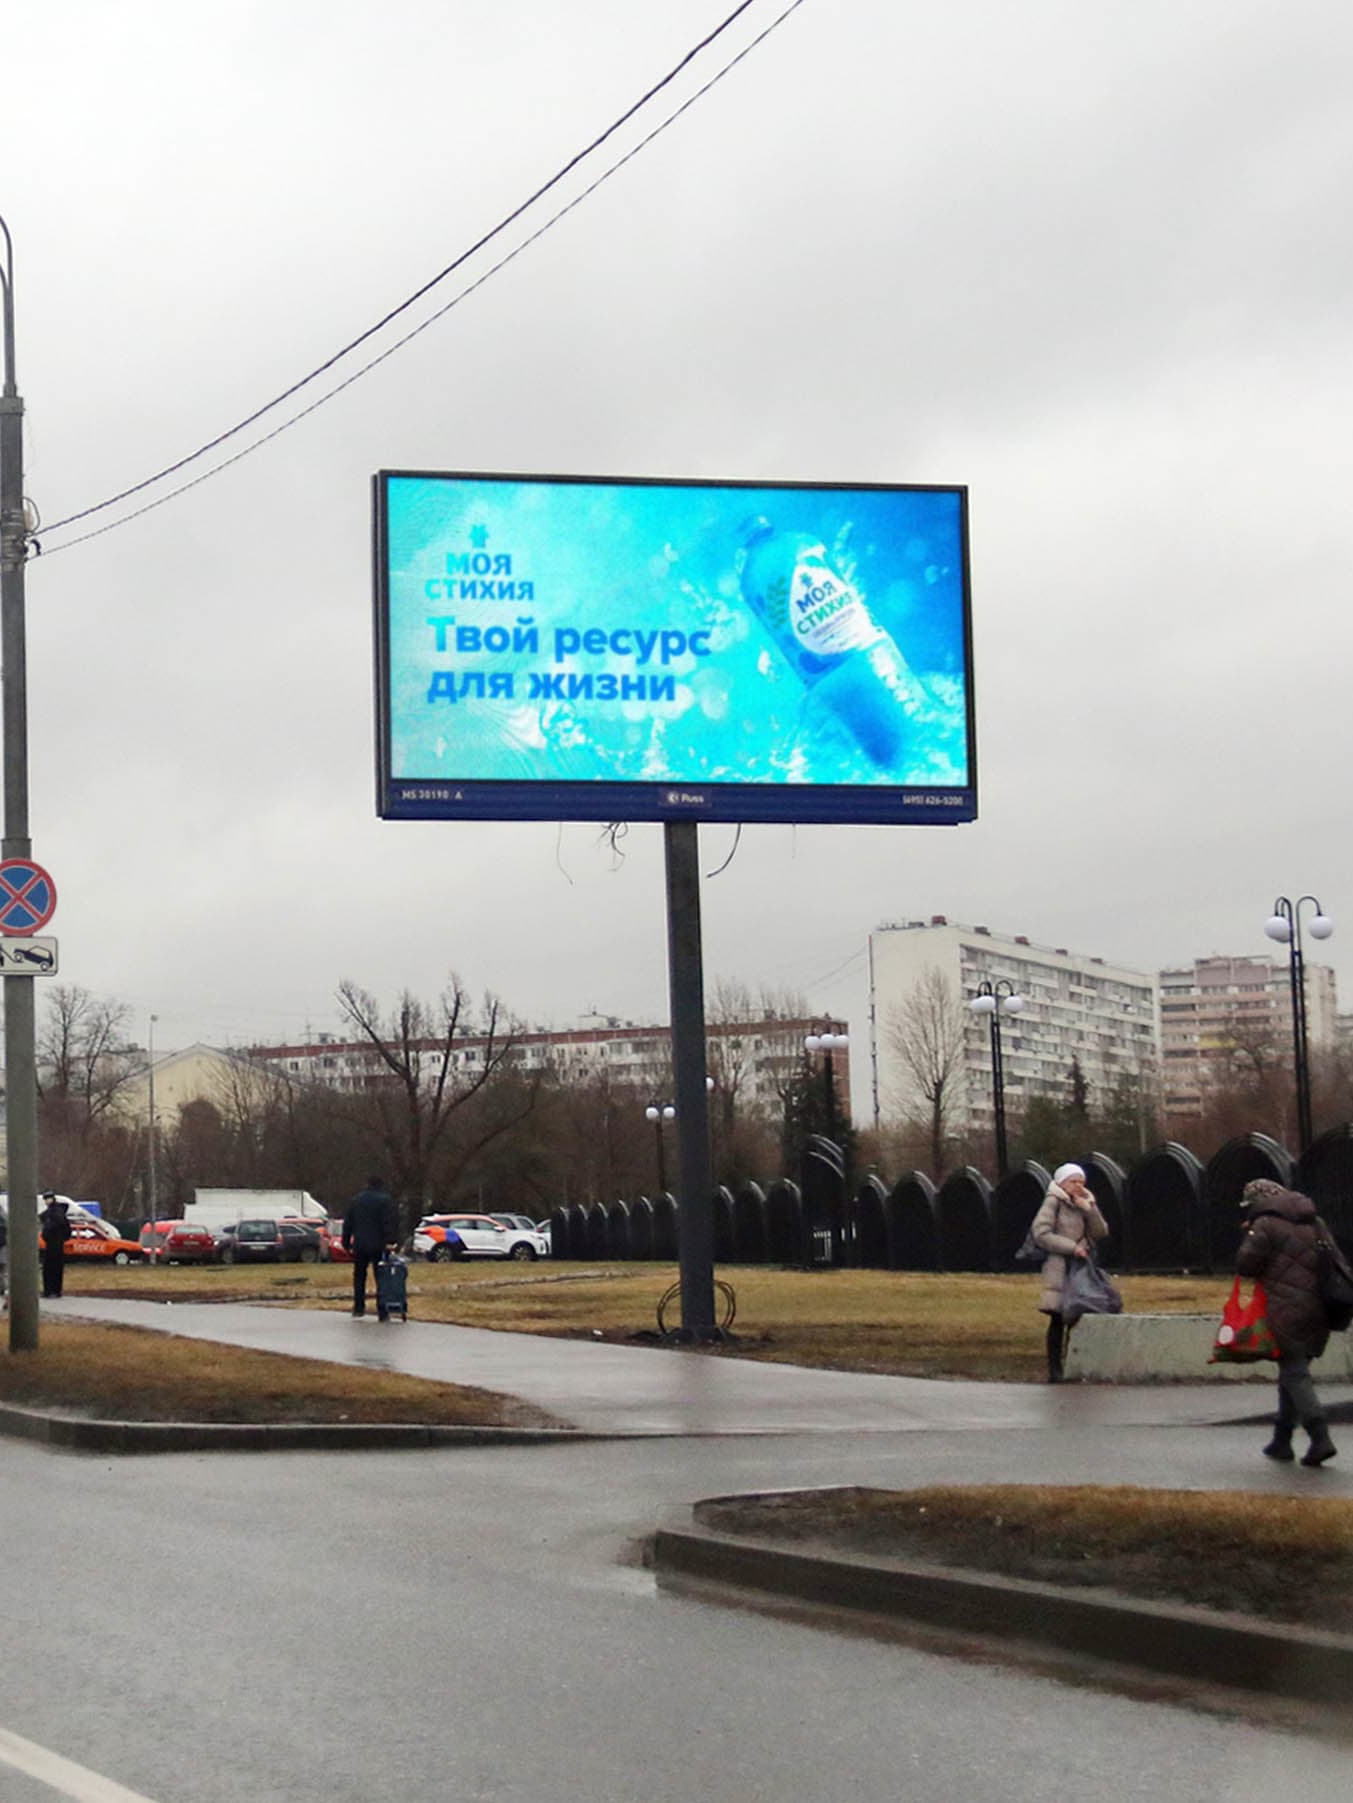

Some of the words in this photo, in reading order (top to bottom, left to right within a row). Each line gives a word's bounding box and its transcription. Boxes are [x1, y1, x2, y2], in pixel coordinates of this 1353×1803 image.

[446, 552, 511, 576] МОЯ
[425, 579, 534, 600] СТИХИЯ
[796, 581, 837, 613] МОЯ
[426, 616, 538, 653] Твой
[555, 628, 712, 665] ресурс
[427, 671, 514, 704] для
[528, 673, 675, 701] жизни
